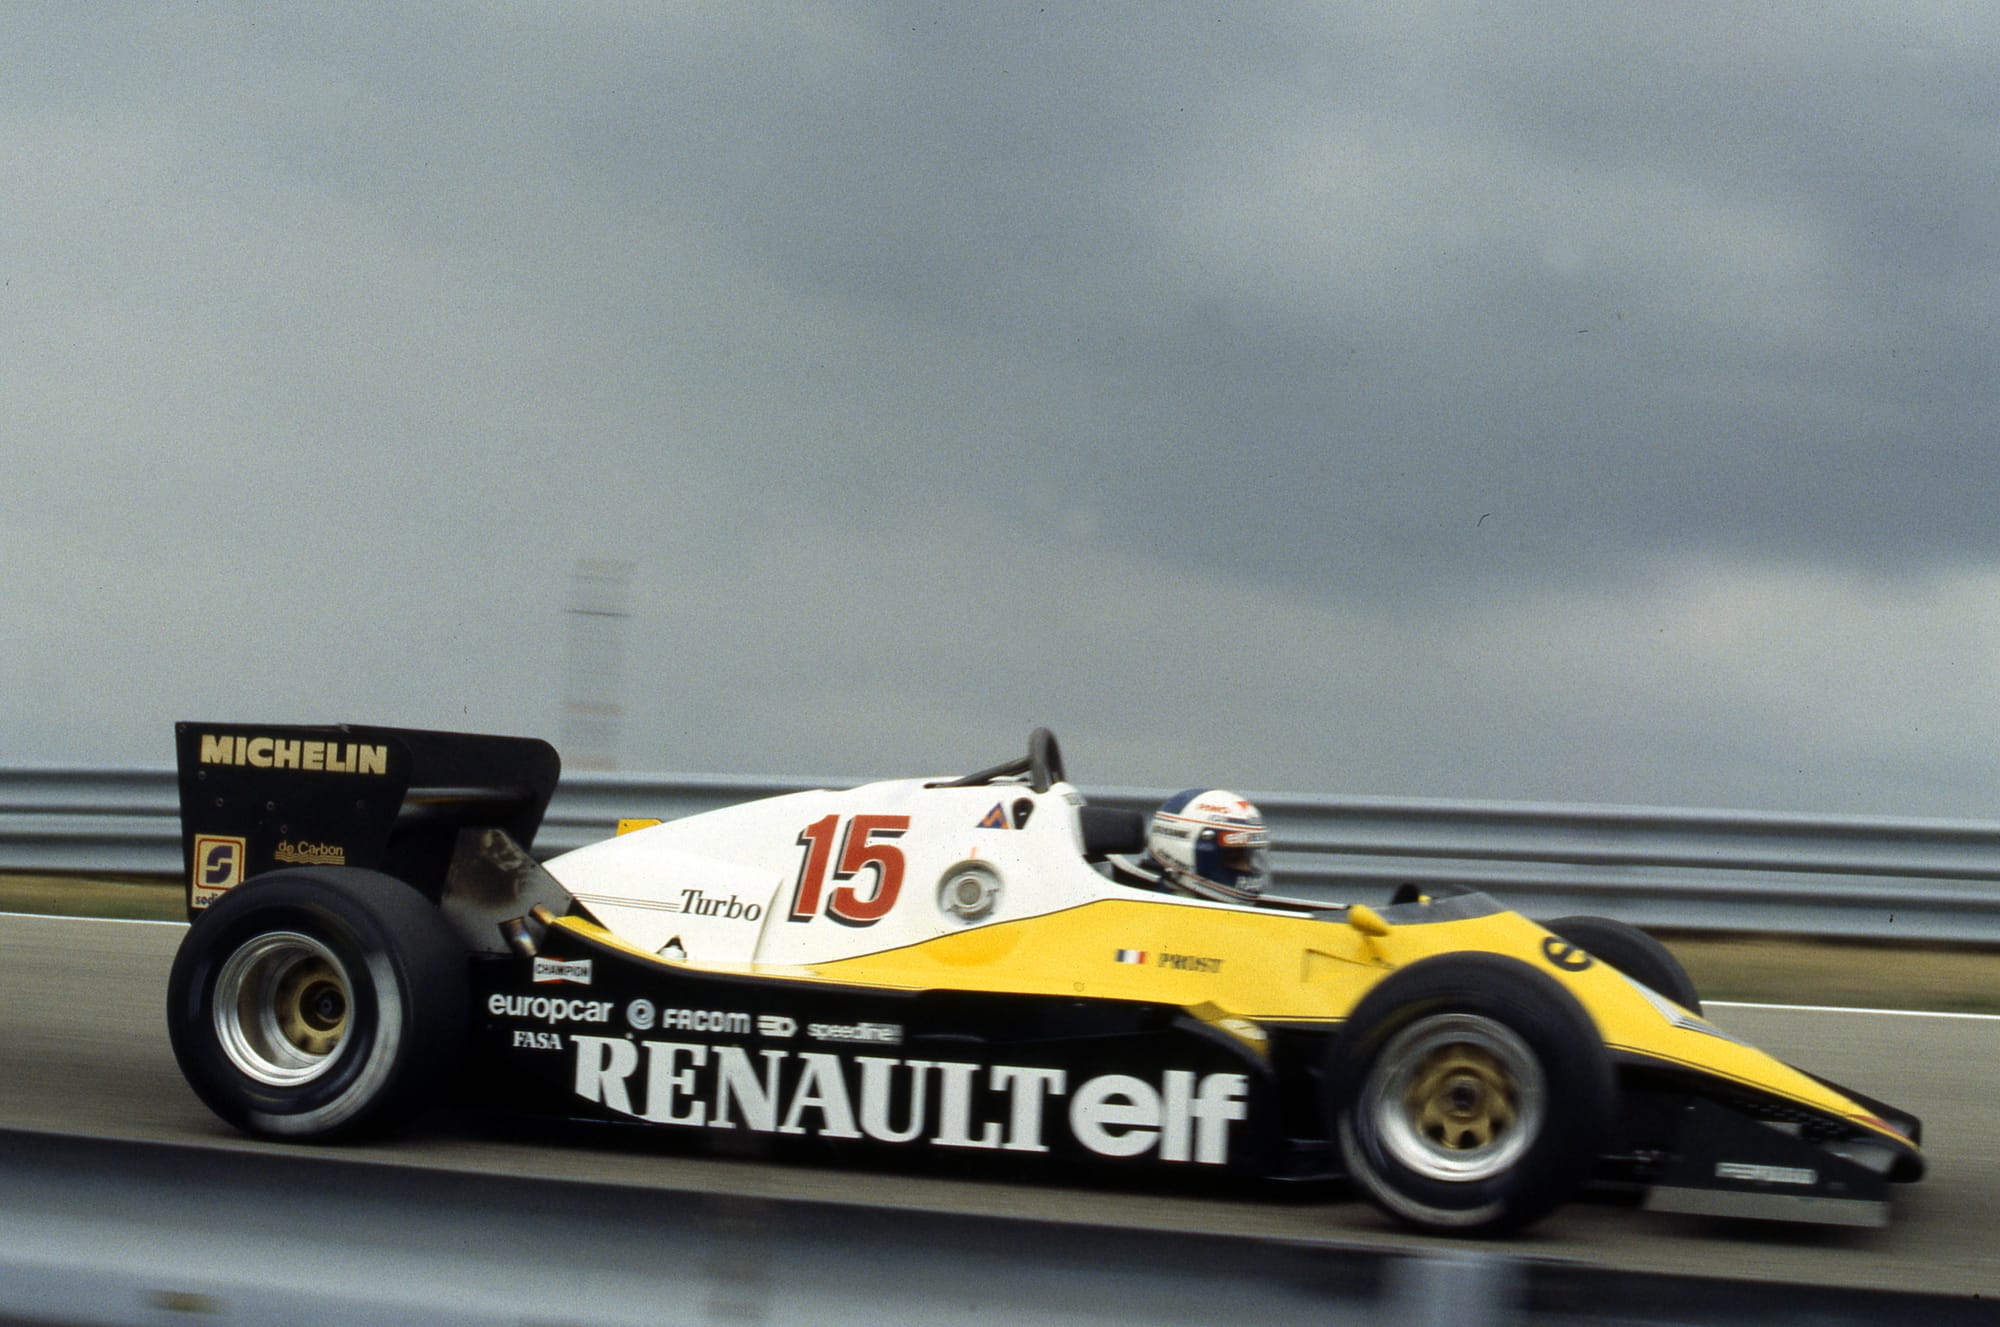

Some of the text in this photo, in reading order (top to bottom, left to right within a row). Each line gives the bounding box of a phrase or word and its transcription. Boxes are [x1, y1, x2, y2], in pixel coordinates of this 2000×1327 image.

[201, 734, 387, 775] MICHELIN
[278, 840, 344, 856] de Carbon
[787, 814, 911, 928] 15
[680, 888, 761, 922] Turbo
[536, 963, 588, 977] CHAMPION
[1158, 952, 1223, 973] PROST
[488, 993, 614, 1025] europcar
[662, 1008, 751, 1034] FACOM
[512, 1031, 563, 1050] FASA
[570, 1034, 1066, 1153] RENAULT
[1069, 1069, 1249, 1165] elf
